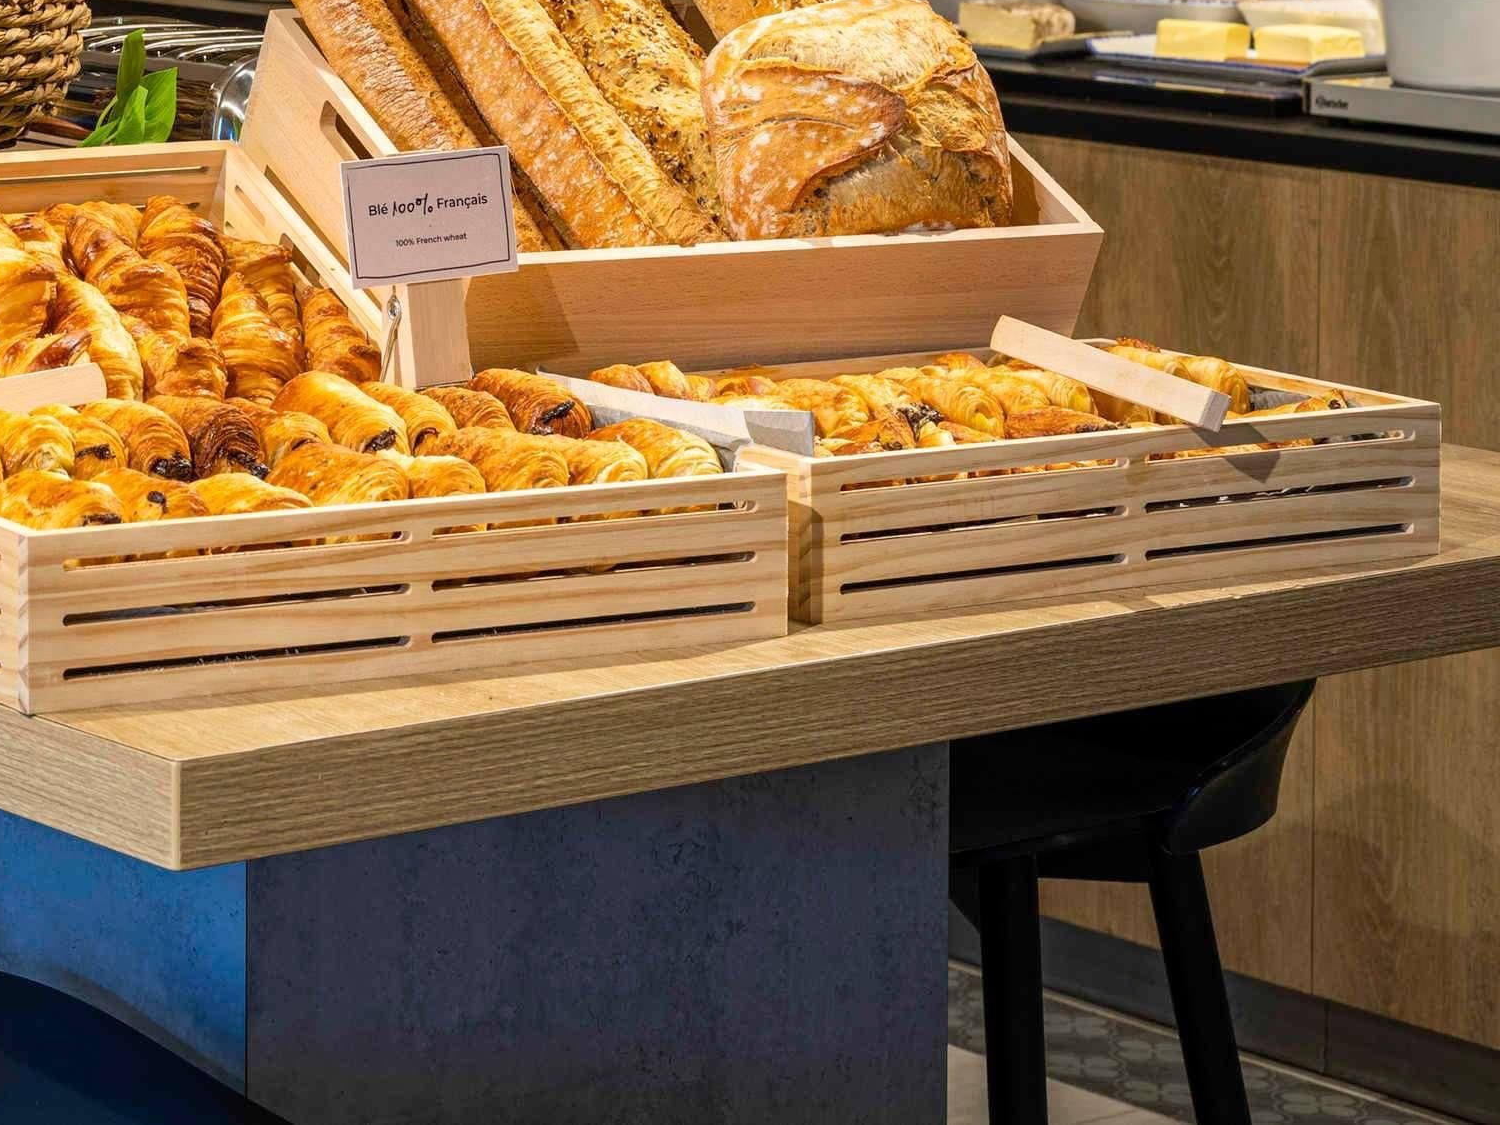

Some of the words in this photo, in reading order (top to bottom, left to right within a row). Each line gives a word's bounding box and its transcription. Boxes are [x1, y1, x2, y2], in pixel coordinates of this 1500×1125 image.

[368, 202, 389, 217] Blé
[392, 193, 433, 217] 100%
[436, 193, 488, 210] Français
[395, 238, 415, 247] 100%
[416, 235, 443, 245] French
